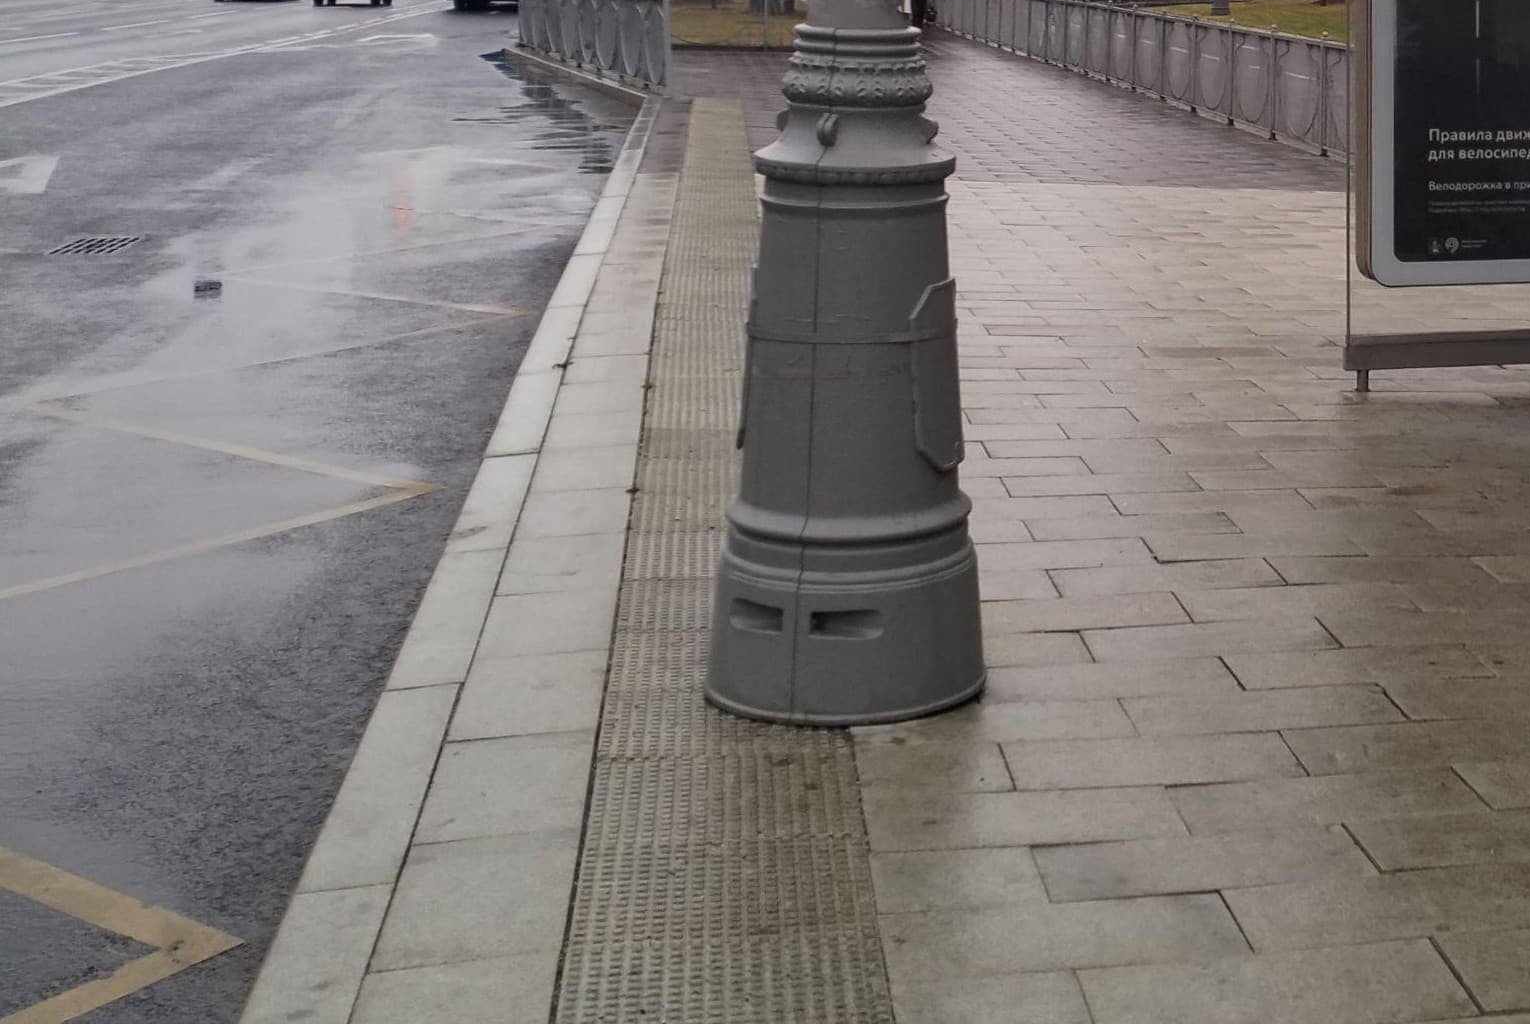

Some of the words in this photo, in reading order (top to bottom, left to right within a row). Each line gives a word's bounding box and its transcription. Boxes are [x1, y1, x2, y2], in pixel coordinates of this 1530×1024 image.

[1428, 128, 1493, 144] Правила
[1428, 149, 1454, 162] для
[1428, 180, 1502, 192] Велодорожка
[1505, 182, 1511, 190] в
